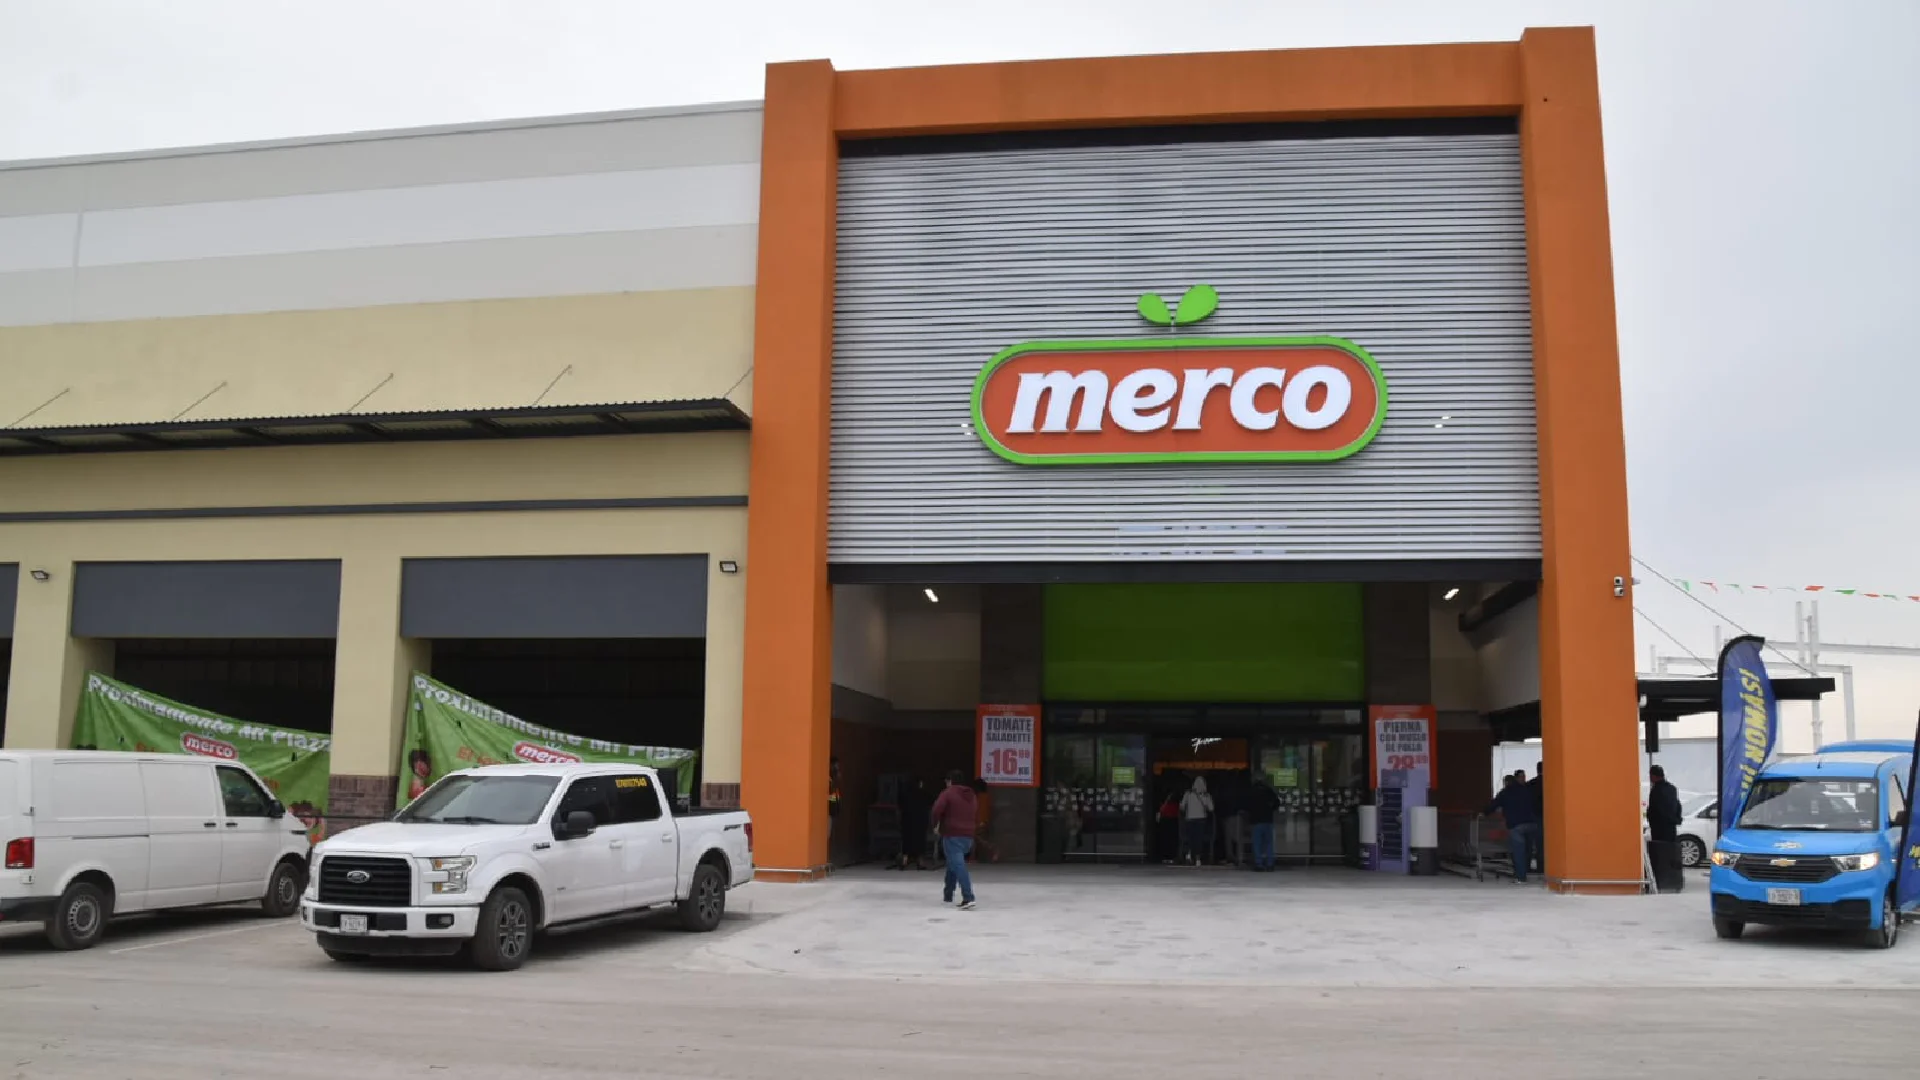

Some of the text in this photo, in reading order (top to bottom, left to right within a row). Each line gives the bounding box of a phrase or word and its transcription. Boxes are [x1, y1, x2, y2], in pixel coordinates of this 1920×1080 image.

[1005, 364, 1352, 434] merco
[986, 717, 1031, 732] TOMATE
[1383, 721, 1422, 733] PIERNA
[186, 737, 233, 758] merco
